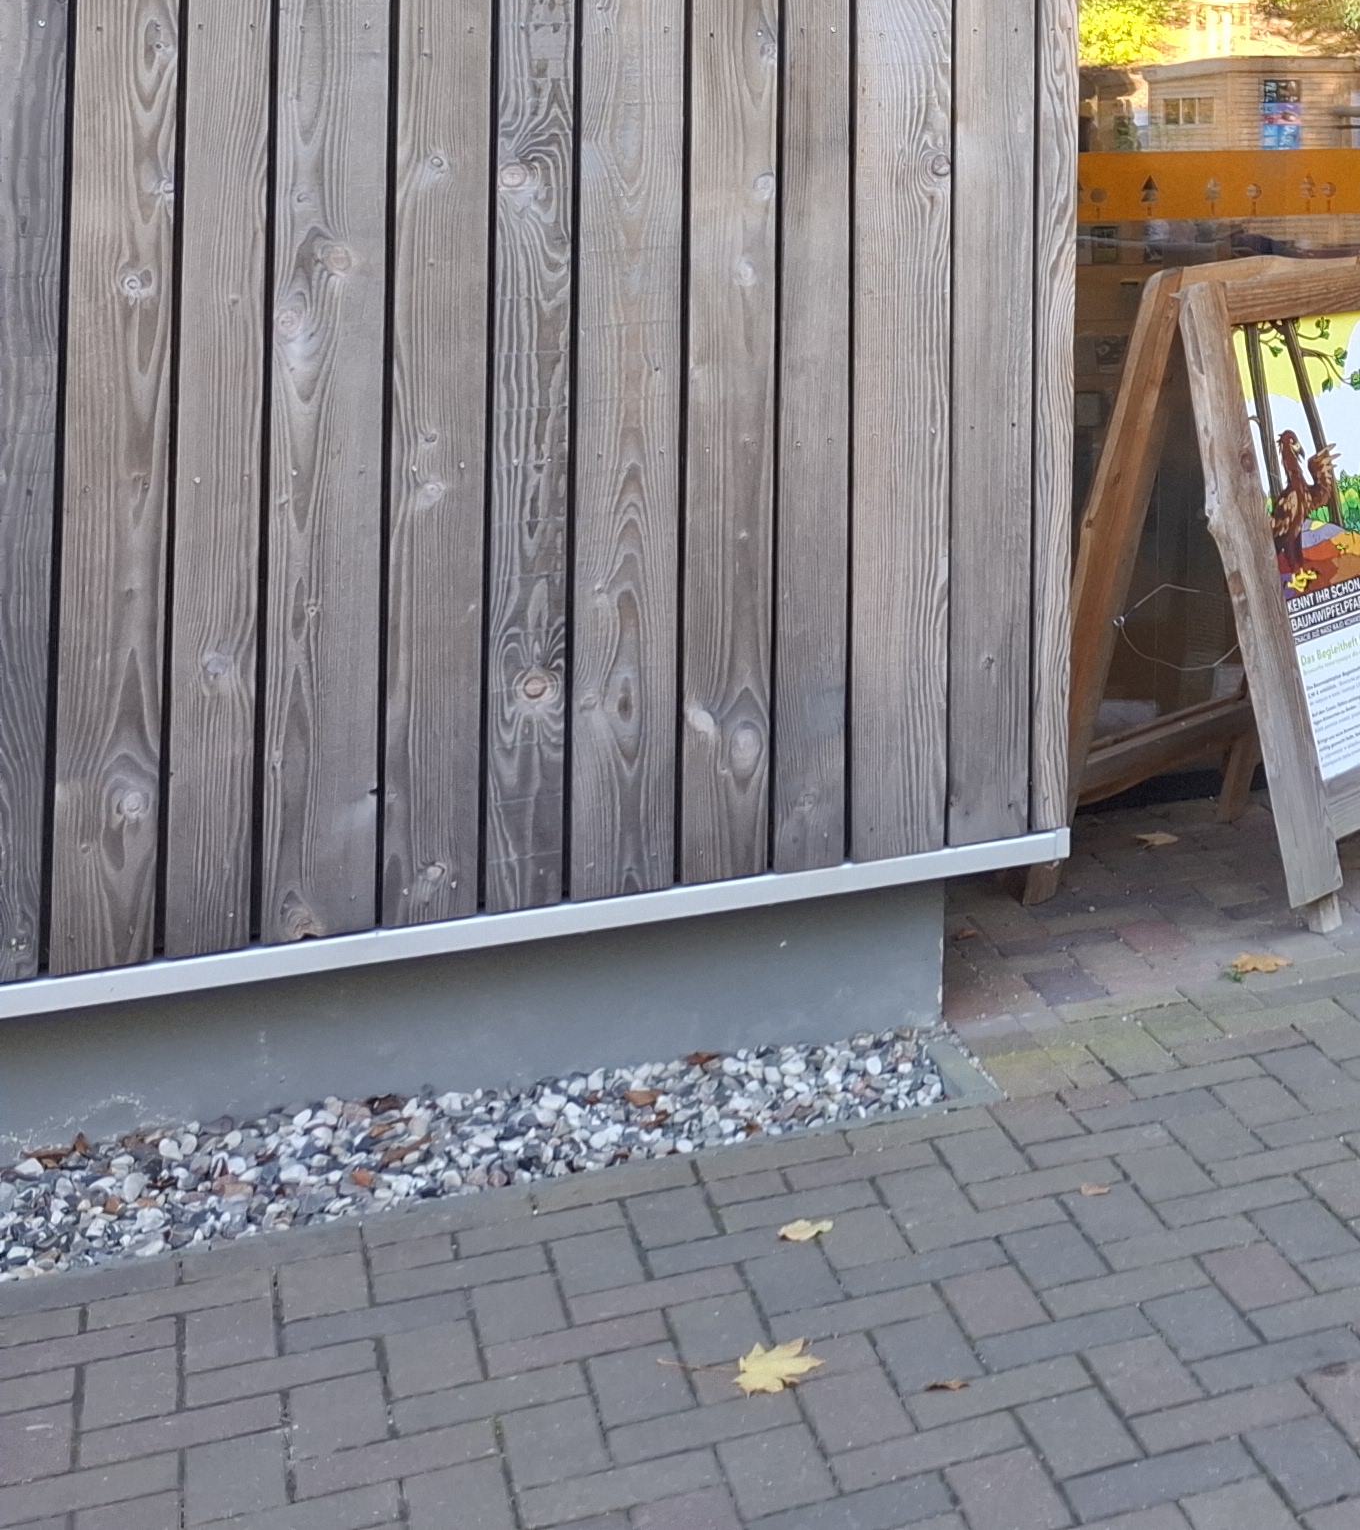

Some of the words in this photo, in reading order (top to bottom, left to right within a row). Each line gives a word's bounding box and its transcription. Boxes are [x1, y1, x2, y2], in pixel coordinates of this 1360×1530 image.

[1287, 593, 1314, 613] KENNT
[1315, 589, 1330, 604] IHR
[1331, 578, 1360, 598] SCHON
[1300, 654, 1315, 666] Das
[1316, 638, 1358, 660] Begleitheft
